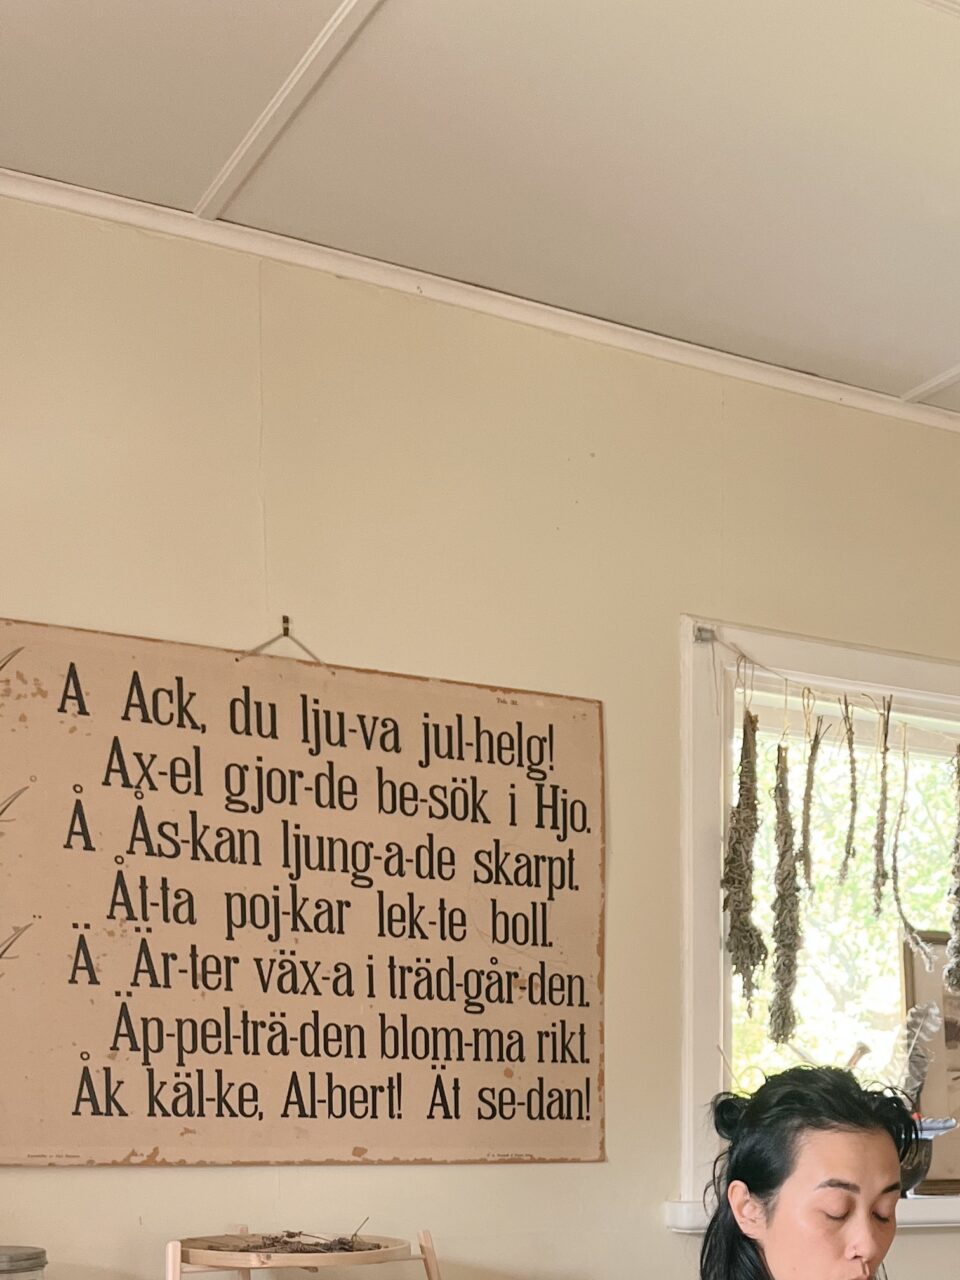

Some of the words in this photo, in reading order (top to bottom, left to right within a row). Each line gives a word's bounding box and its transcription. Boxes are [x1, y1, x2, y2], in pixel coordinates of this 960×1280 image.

[57, 661, 91, 717] A
[120, 670, 207, 734] Ack,
[229, 685, 279, 740] du
[299, 693, 402, 757] lju-va
[418, 712, 554, 784] jul-helg!
[101, 735, 204, 797] Ax-el
[224, 755, 358, 815] gjor-de
[375, 766, 492, 825] be-sök
[508, 783, 518, 827] i
[534, 782, 591, 843] Hjo.
[63, 783, 96, 852] Å
[125, 789, 264, 867] Ås-kan
[281, 819, 456, 889] ljung-a-de
[473, 838, 580, 902] skarpt.
[106, 855, 197, 926] Åt-ta
[224, 882, 352, 943] poj-kar
[376, 889, 467, 942] lek-te
[490, 897, 554, 948] boll.
[68, 922, 101, 986] Ä
[130, 926, 240, 992] Är-ter
[252, 949, 355, 998] väx-a
[366, 954, 376, 999] i
[387, 955, 591, 1015] träd-går-den.
[109, 990, 367, 1067] Äp-pel-trä-den
[378, 1012, 526, 1063] blom-ma
[536, 1019, 591, 1065] rikt.
[71, 1051, 129, 1117] Åk
[146, 1067, 264, 1121] käl-ke,
[280, 1070, 403, 1120] Al-bert!
[426, 1064, 461, 1120] Ät
[477, 1076, 591, 1122] se-dan!
